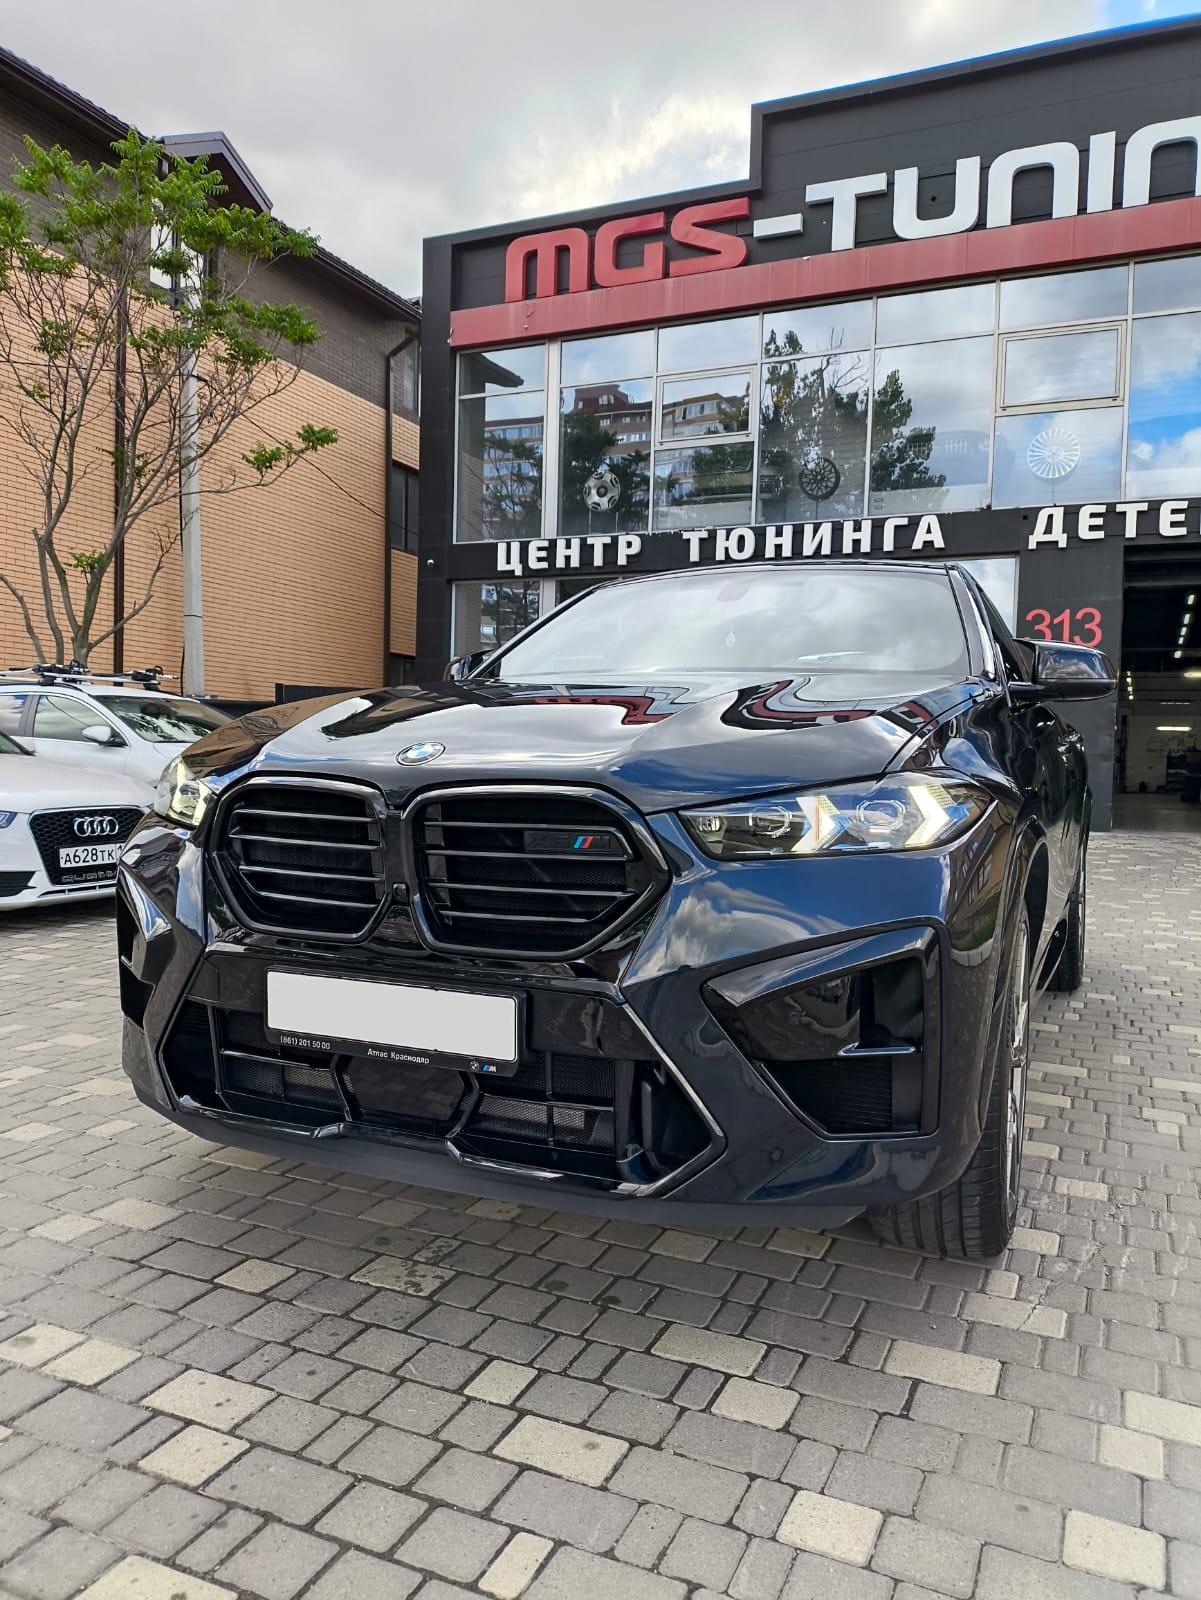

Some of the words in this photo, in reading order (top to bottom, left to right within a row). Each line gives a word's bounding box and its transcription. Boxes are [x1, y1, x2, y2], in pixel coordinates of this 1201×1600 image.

[497, 534, 642, 576] ЦЕНТР
[682, 515, 946, 562] ТЮНИНГА
[1028, 500, 1201, 550] ДЕТЕ
[1025, 607, 1103, 648] 313
[298, 1038, 311, 1047] 201
[321, 1041, 331, 1050] 00
[390, 1051, 429, 1065] Краснодар
